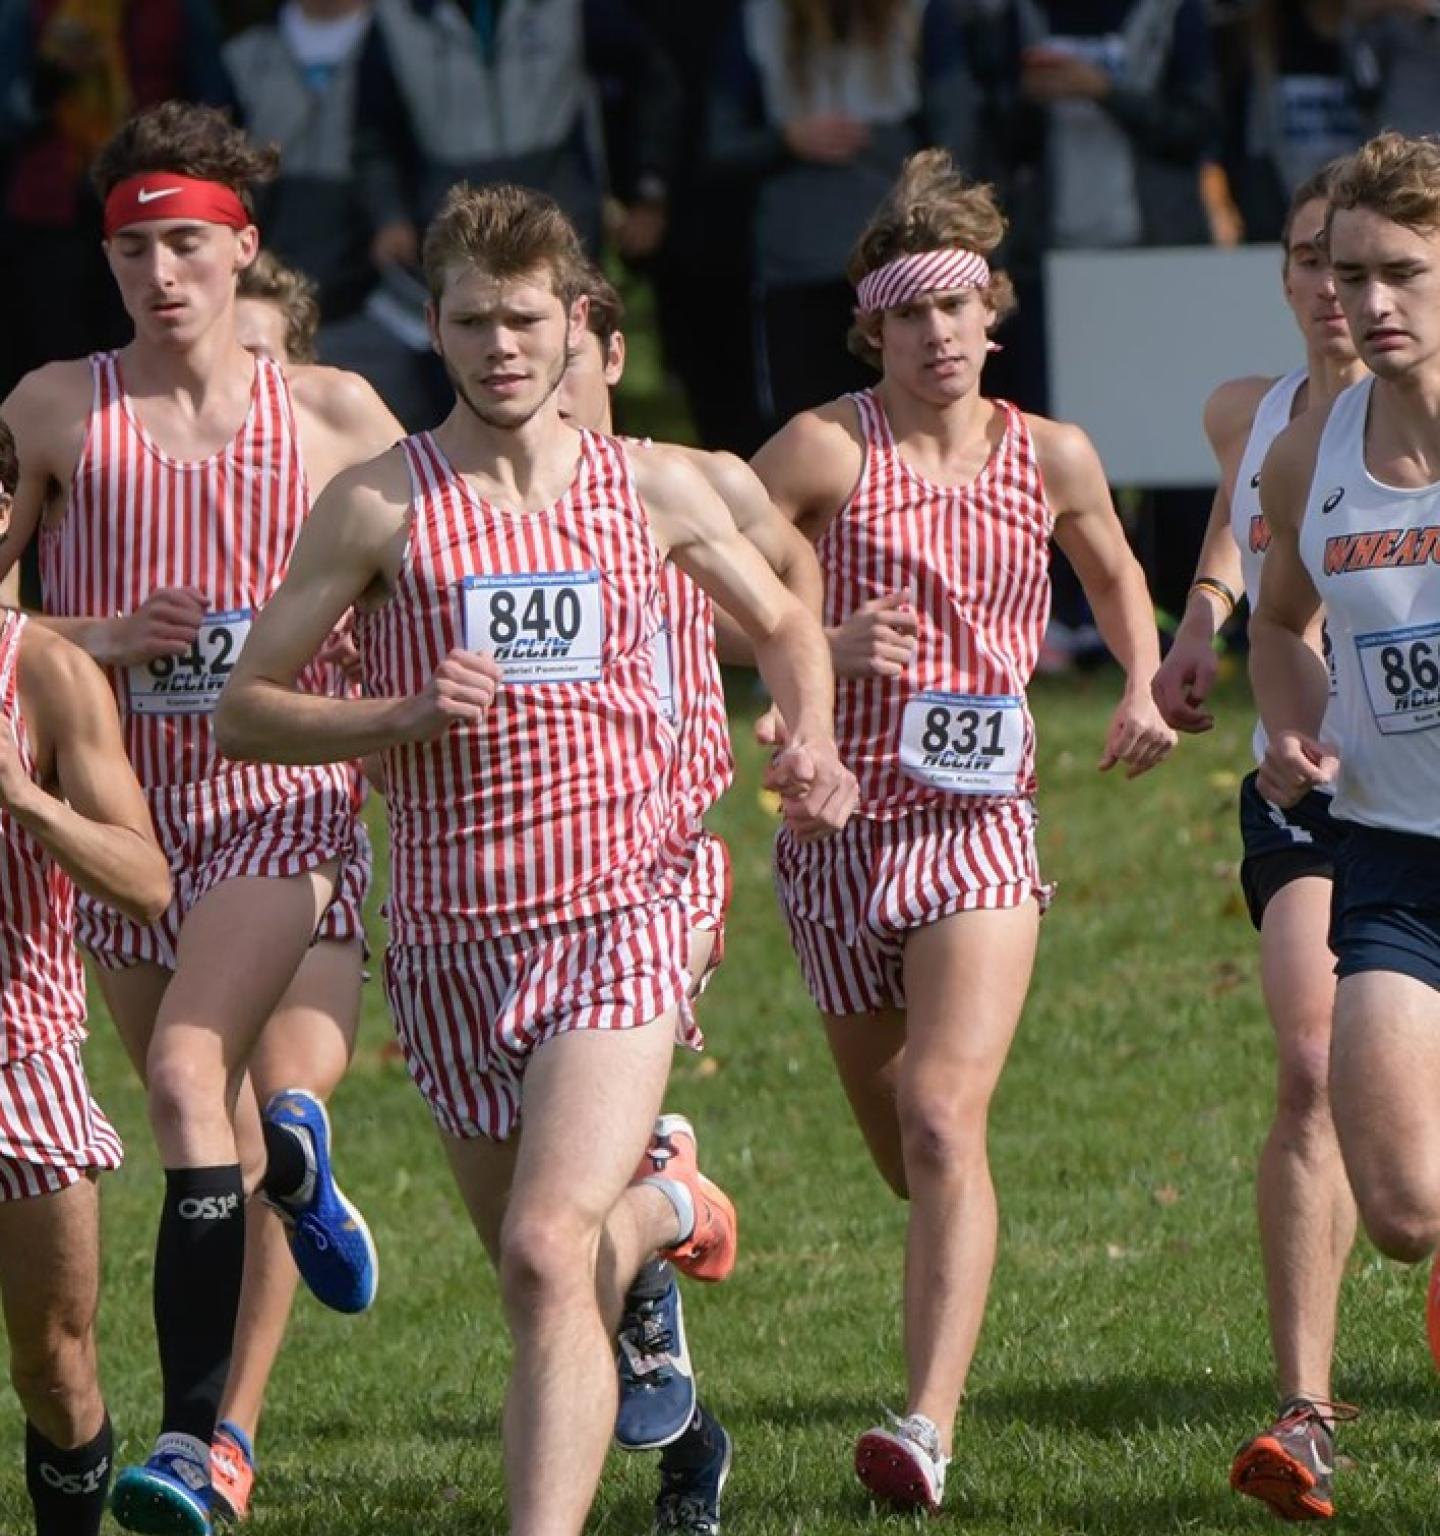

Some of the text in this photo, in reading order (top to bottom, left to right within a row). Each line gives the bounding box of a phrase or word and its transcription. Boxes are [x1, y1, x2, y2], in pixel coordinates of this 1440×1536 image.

[489, 587, 582, 644] 840
[1381, 641, 1440, 696] 86
[922, 707, 1005, 755] 831
[178, 1191, 238, 1219] OS1st
